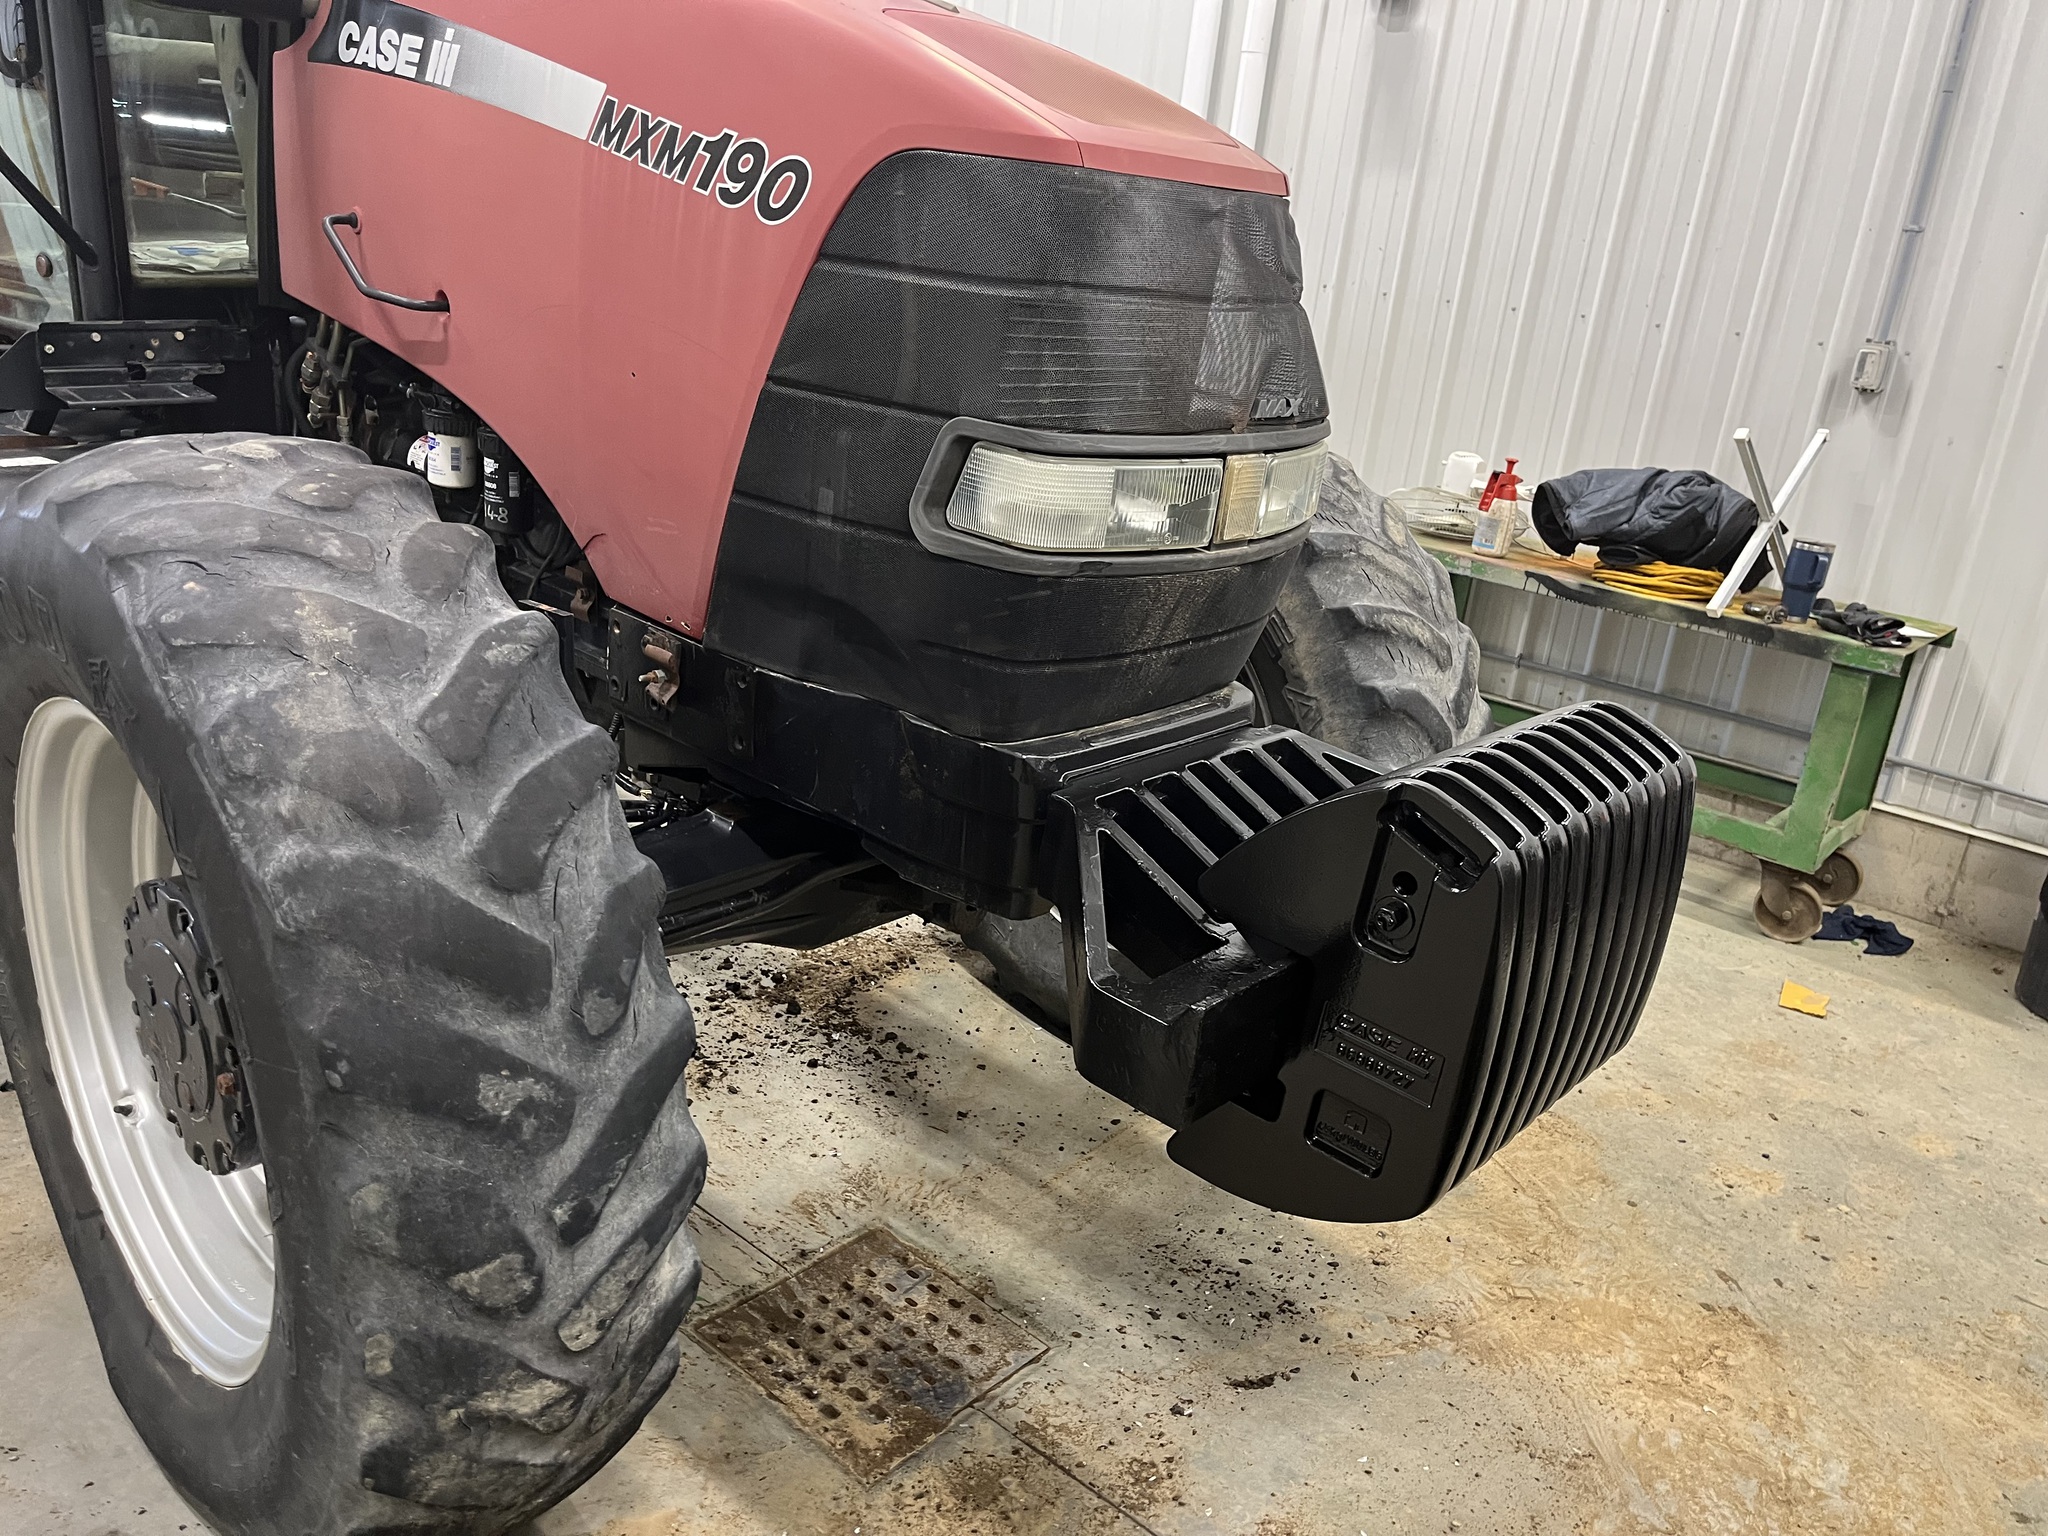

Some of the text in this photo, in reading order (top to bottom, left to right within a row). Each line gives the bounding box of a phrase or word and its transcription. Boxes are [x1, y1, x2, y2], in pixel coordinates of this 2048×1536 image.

[338, 20, 425, 79] CASE
[588, 94, 812, 226] MXM190
[1337, 1012, 1402, 1053] CASE
